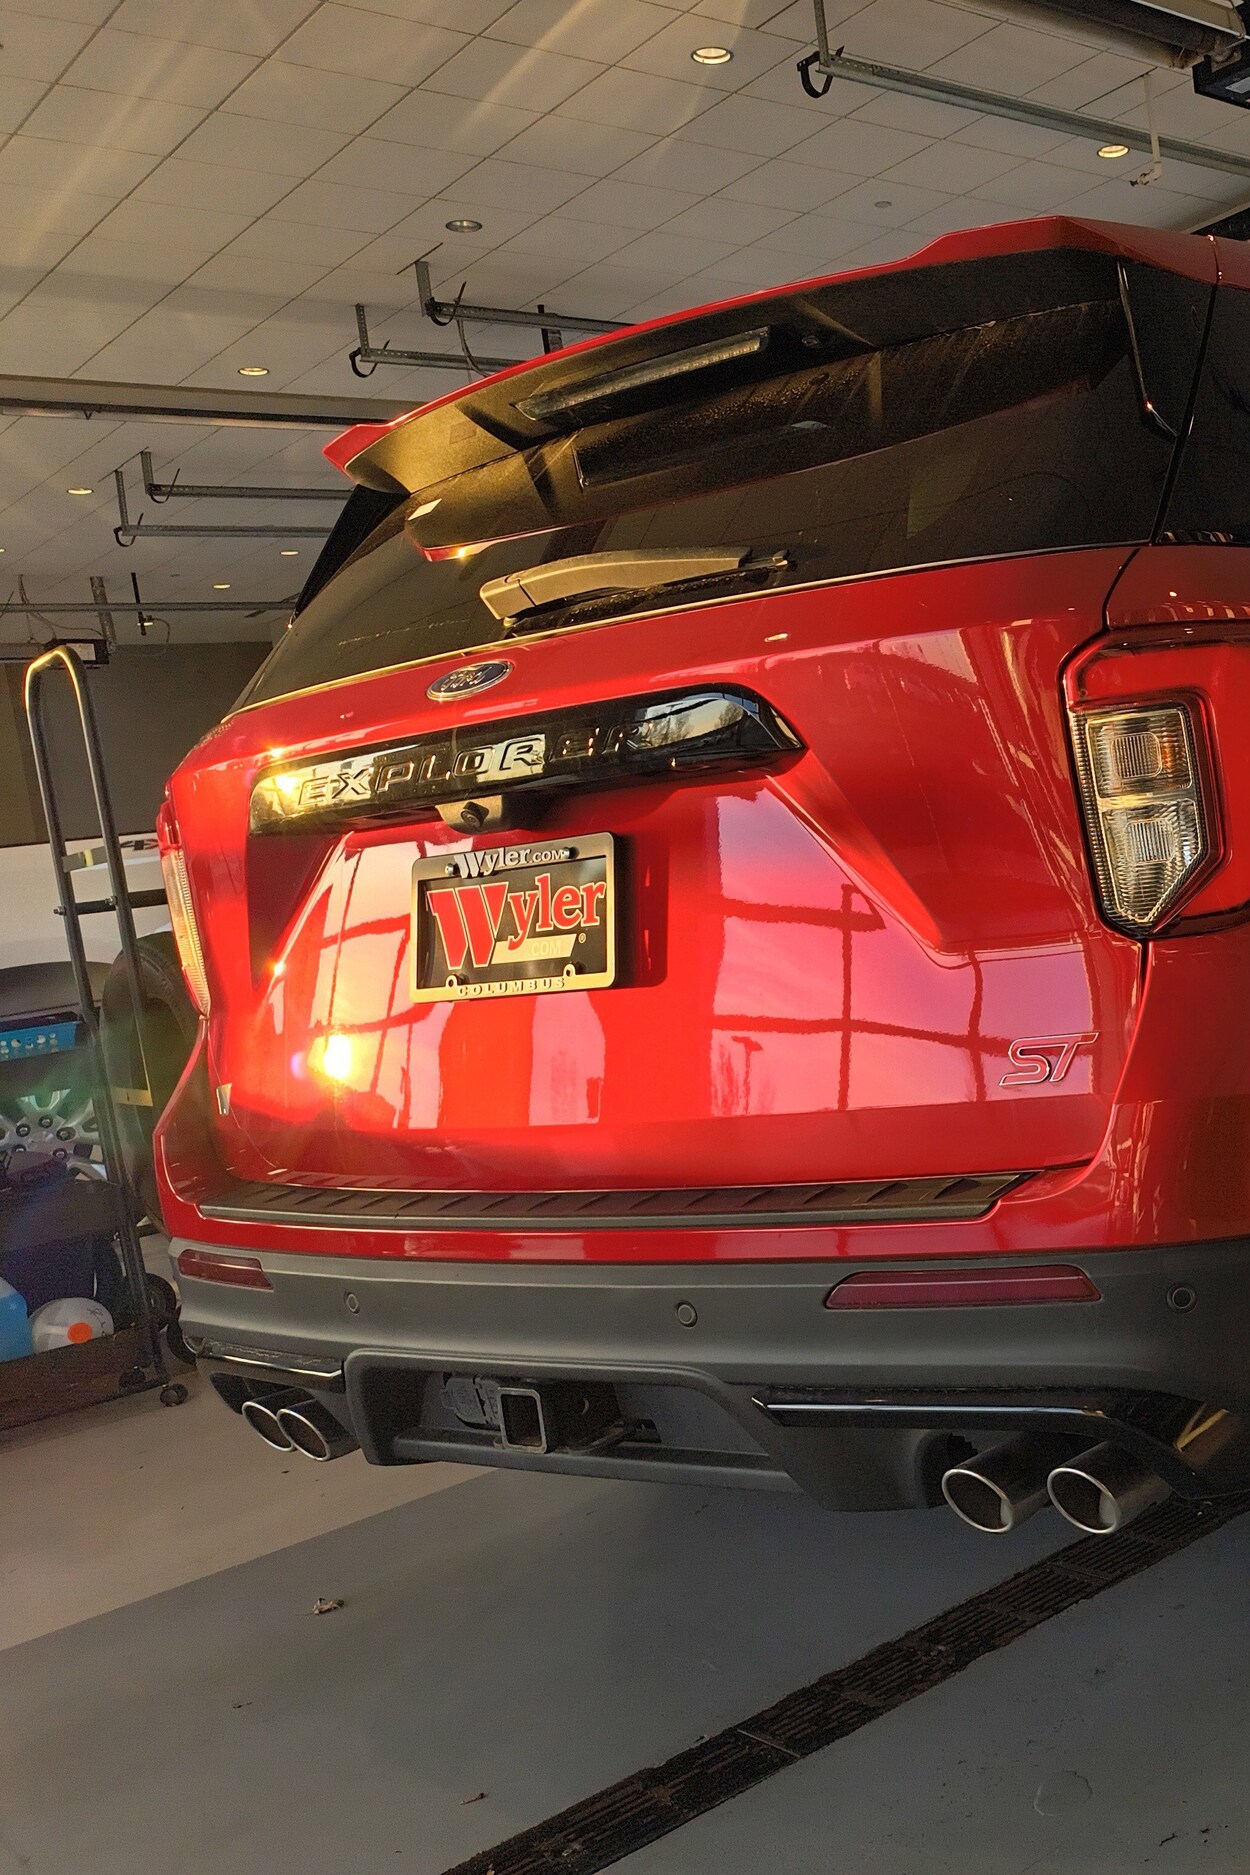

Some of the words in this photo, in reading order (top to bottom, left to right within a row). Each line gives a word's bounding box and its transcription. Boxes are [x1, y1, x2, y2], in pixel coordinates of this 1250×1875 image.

[440, 665, 493, 692] Ford
[298, 720, 652, 806] EXPLORER
[427, 873, 606, 970] Wyler
[458, 976, 566, 996] COLUMBUS
[998, 1031, 1099, 1086] ST
